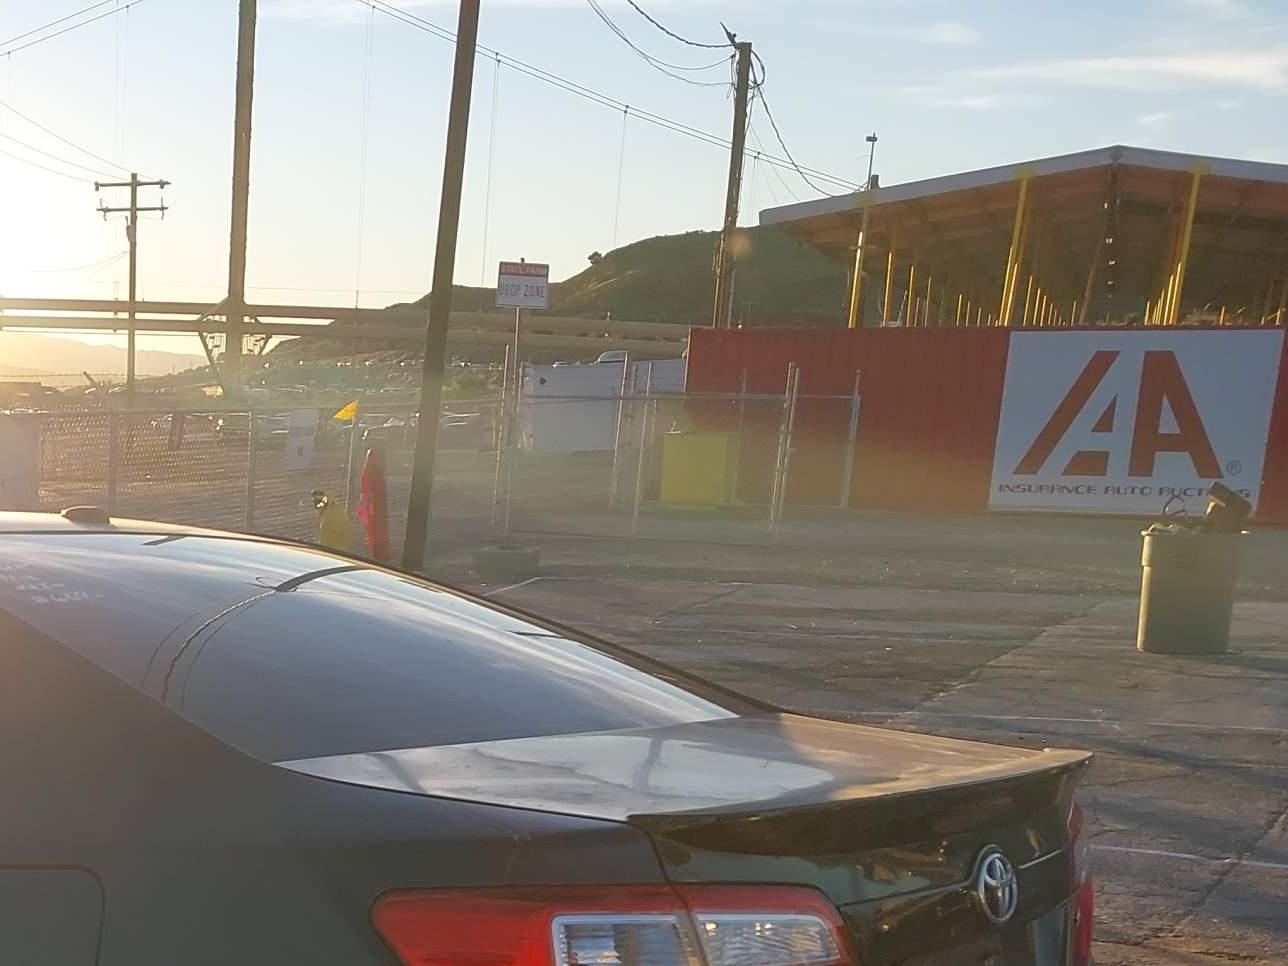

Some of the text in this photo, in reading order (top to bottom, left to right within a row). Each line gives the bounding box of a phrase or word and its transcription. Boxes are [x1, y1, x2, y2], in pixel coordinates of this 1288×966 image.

[523, 284, 546, 298] ZONE
[998, 483, 1098, 495] INSURANCE
[1103, 485, 1153, 496] AUTO
